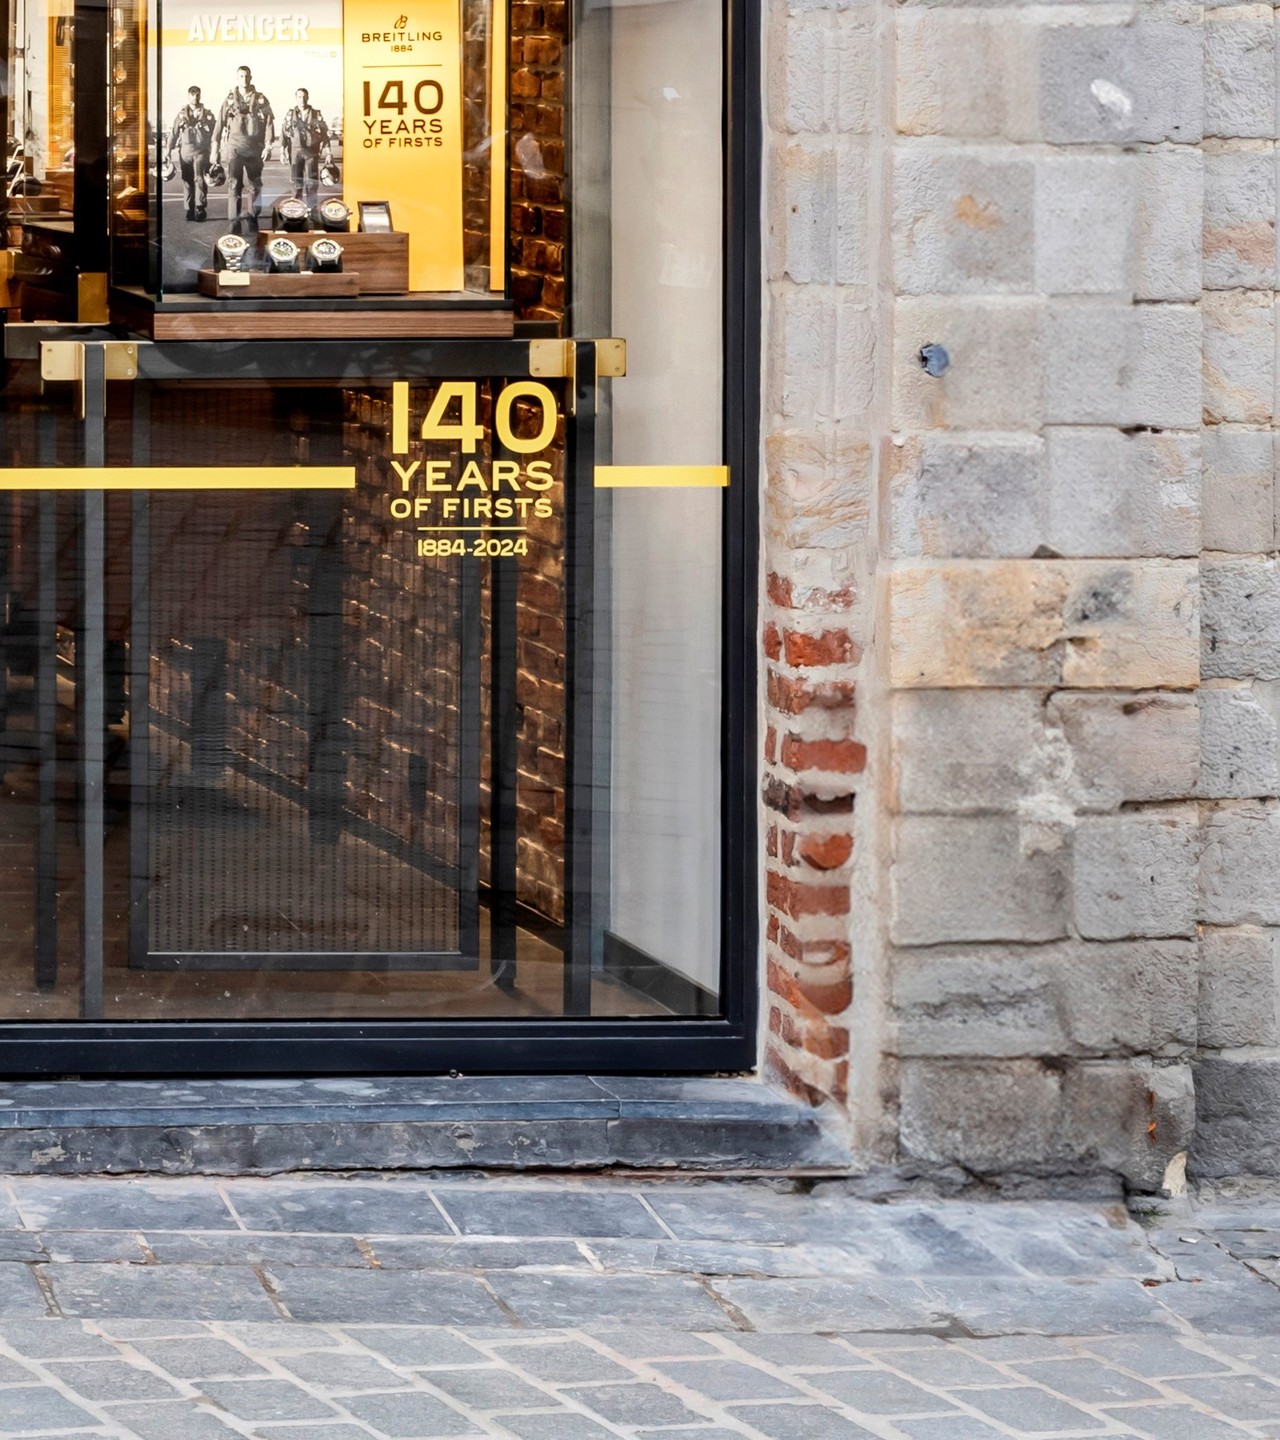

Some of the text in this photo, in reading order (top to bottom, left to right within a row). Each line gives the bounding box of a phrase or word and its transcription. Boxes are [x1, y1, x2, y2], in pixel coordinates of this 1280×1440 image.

[187, 13, 311, 43] AVENGER
[361, 31, 443, 43] BREITLING
[390, 44, 413, 53] 1884
[363, 79, 444, 117] 140
[363, 118, 443, 135] YEARS
[363, 136, 443, 149] OF FIRSTS
[392, 381, 558, 455] 140
[390, 461, 554, 492] YEARS
[390, 498, 553, 519] OF FIRSTS
[417, 539, 529, 557] 1884-2024
